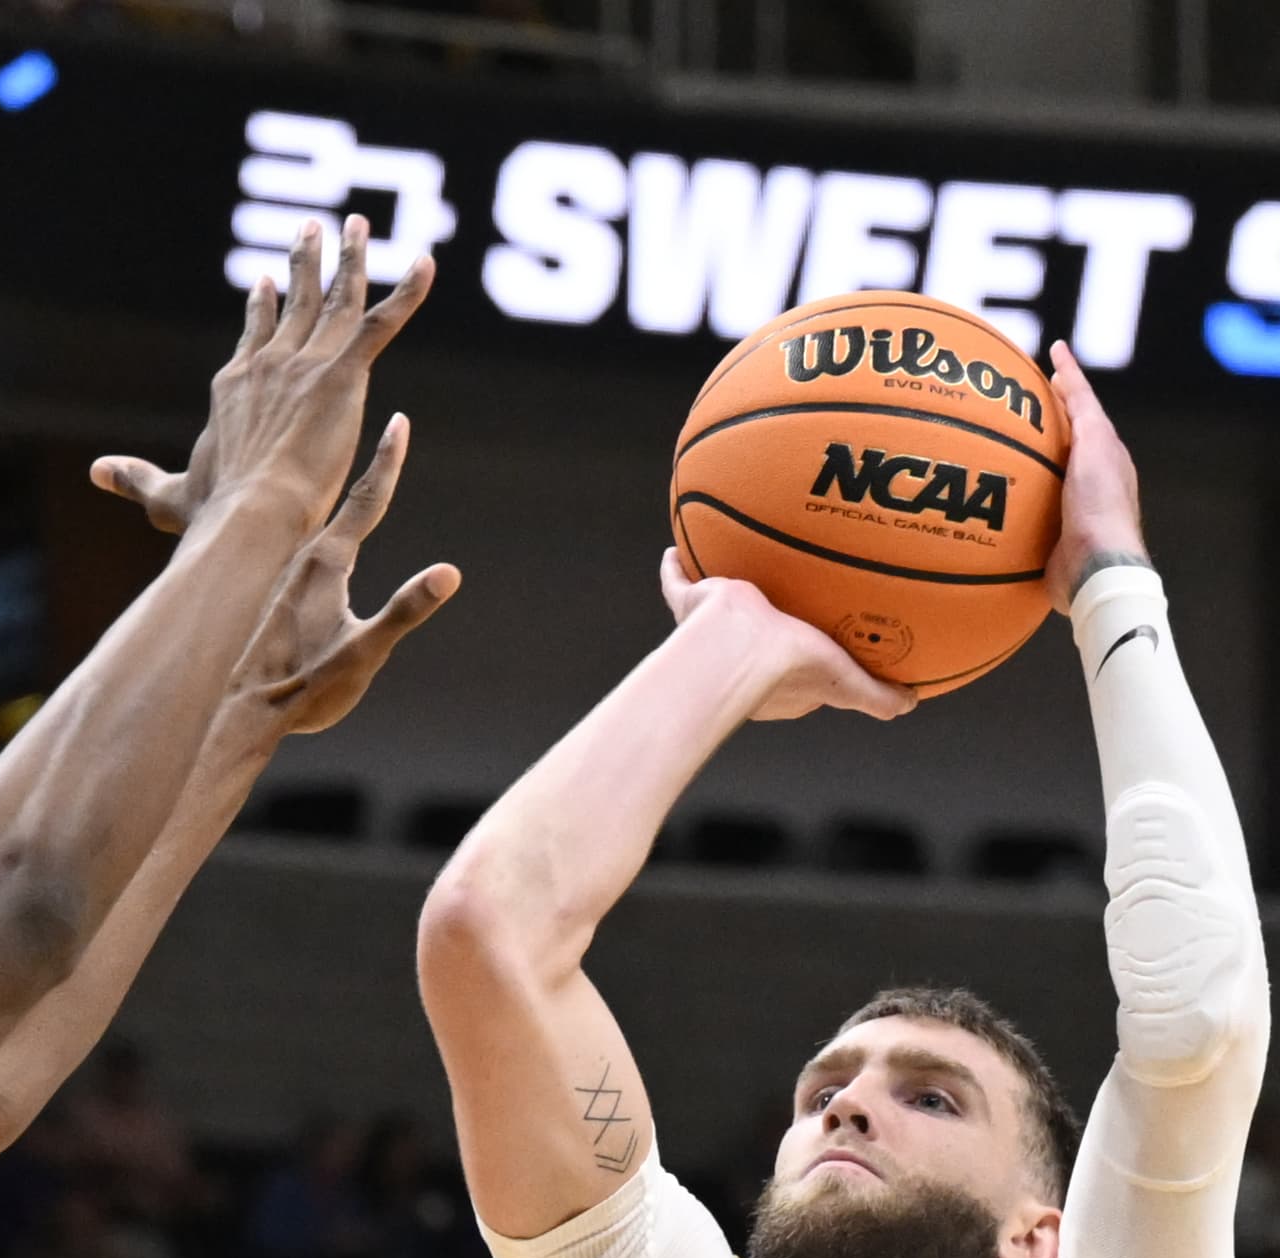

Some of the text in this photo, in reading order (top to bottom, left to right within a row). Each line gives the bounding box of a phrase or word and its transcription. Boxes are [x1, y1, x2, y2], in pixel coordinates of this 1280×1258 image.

[482, 140, 1195, 369] SWEET
[779, 325, 1044, 434] Wilson
[883, 377, 968, 400] EVO NXT
[805, 502, 997, 547] OFFICIAL GAME BALL
[809, 442, 1008, 532] NCAA
